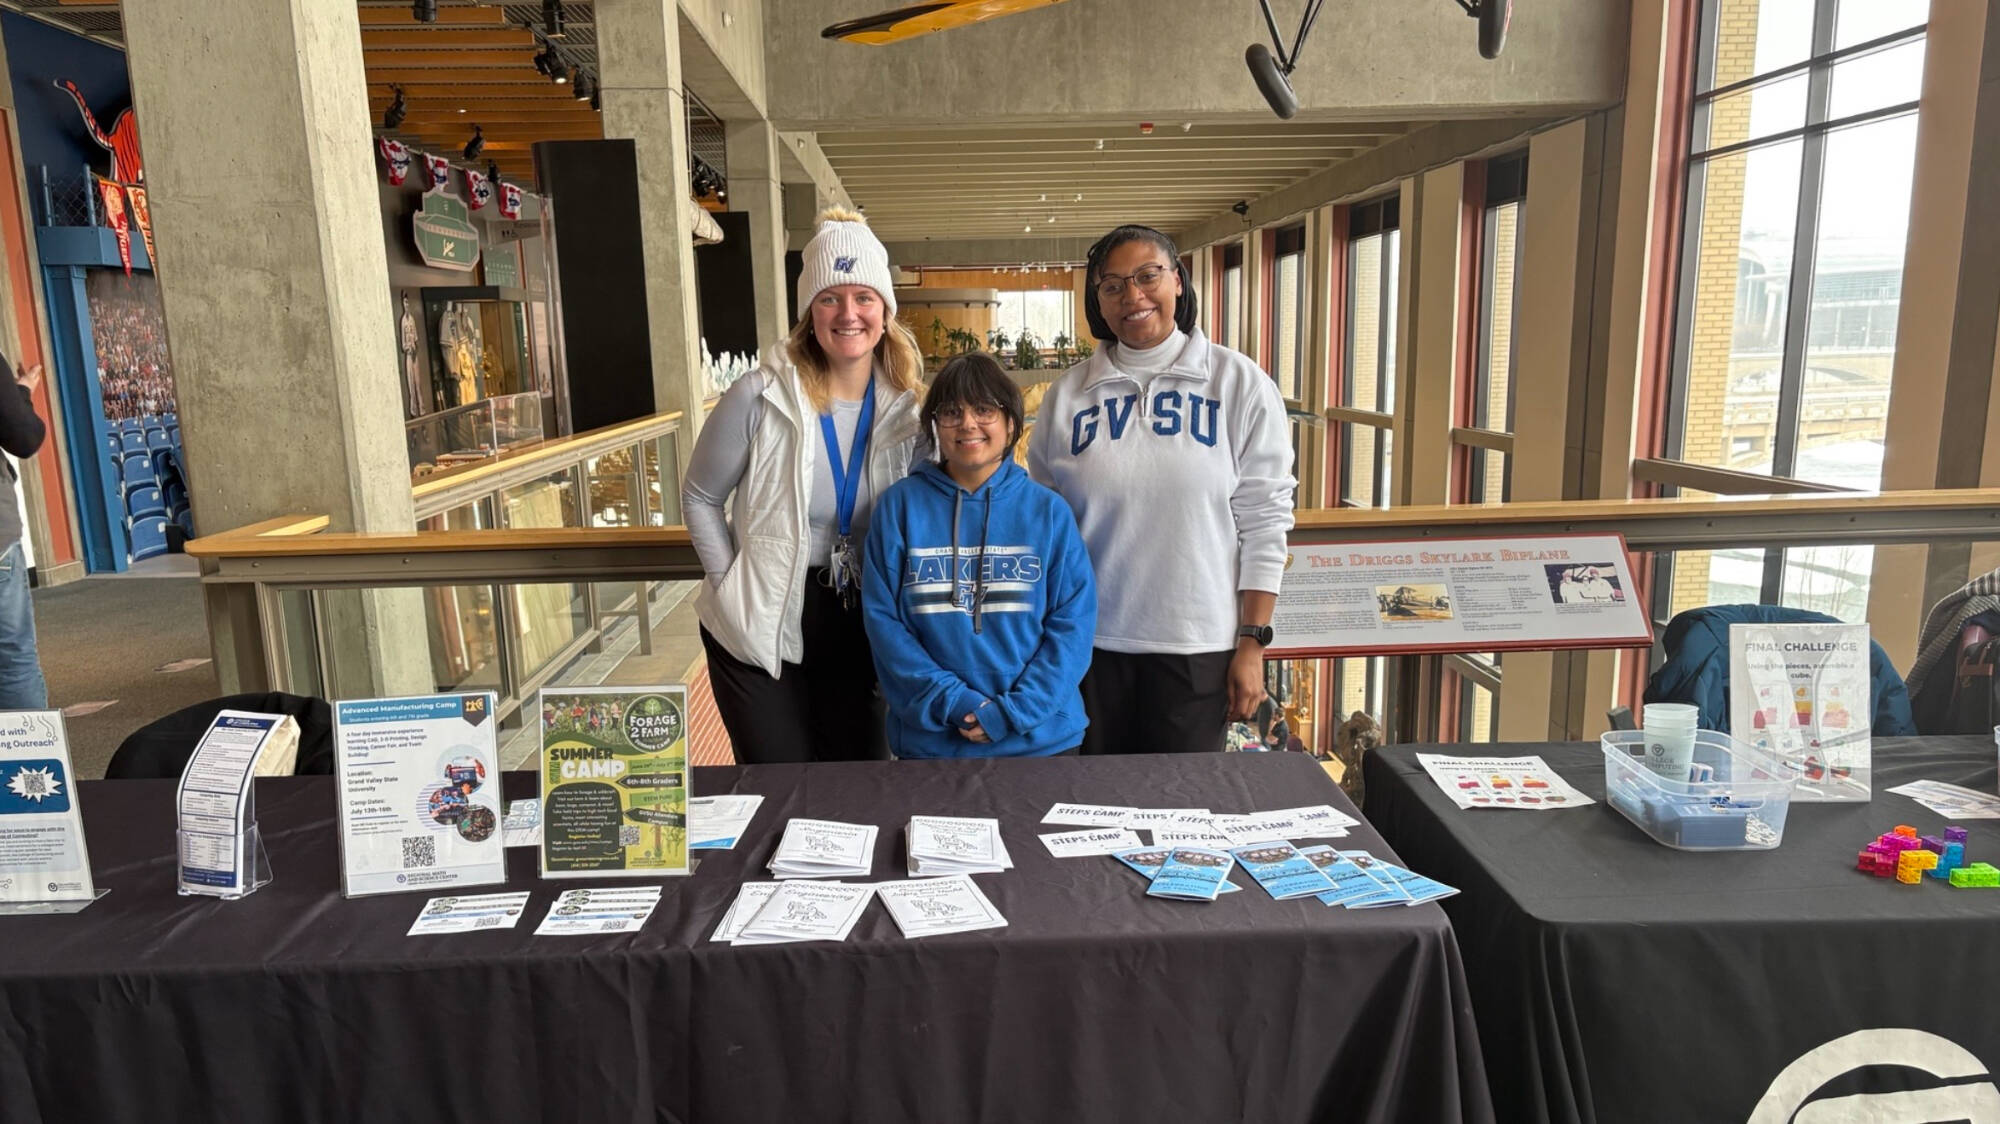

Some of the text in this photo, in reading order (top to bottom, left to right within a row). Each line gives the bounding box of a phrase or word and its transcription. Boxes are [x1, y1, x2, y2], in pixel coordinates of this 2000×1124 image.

[1071, 390, 1220, 456] GVSU
[1307, 549, 1570, 568] THE DRIGGS SKYLARK BIPLANE
[904, 555, 1042, 586] LAKERS
[1745, 642, 1857, 652] FINAL CHALLENGE
[1785, 662, 1812, 671] pieces,
[341, 701, 457, 715] Advanced Manufacturing Camp
[629, 715, 678, 727] FORAGE
[630, 728, 669, 739] 2 FARM
[13, 739, 54, 747] Outreach
[634, 739, 656, 750] SUMMER
[550, 747, 613, 760] SUMMER
[561, 759, 625, 778] CAMP
[1057, 808, 1126, 818] STEPS CAMP
[1178, 815, 1214, 825] STEPS
[1225, 821, 1294, 834] STEPS CAMP
[1051, 833, 1121, 846] STEPS CAMP
[1161, 833, 1227, 841] STEPS CAM
